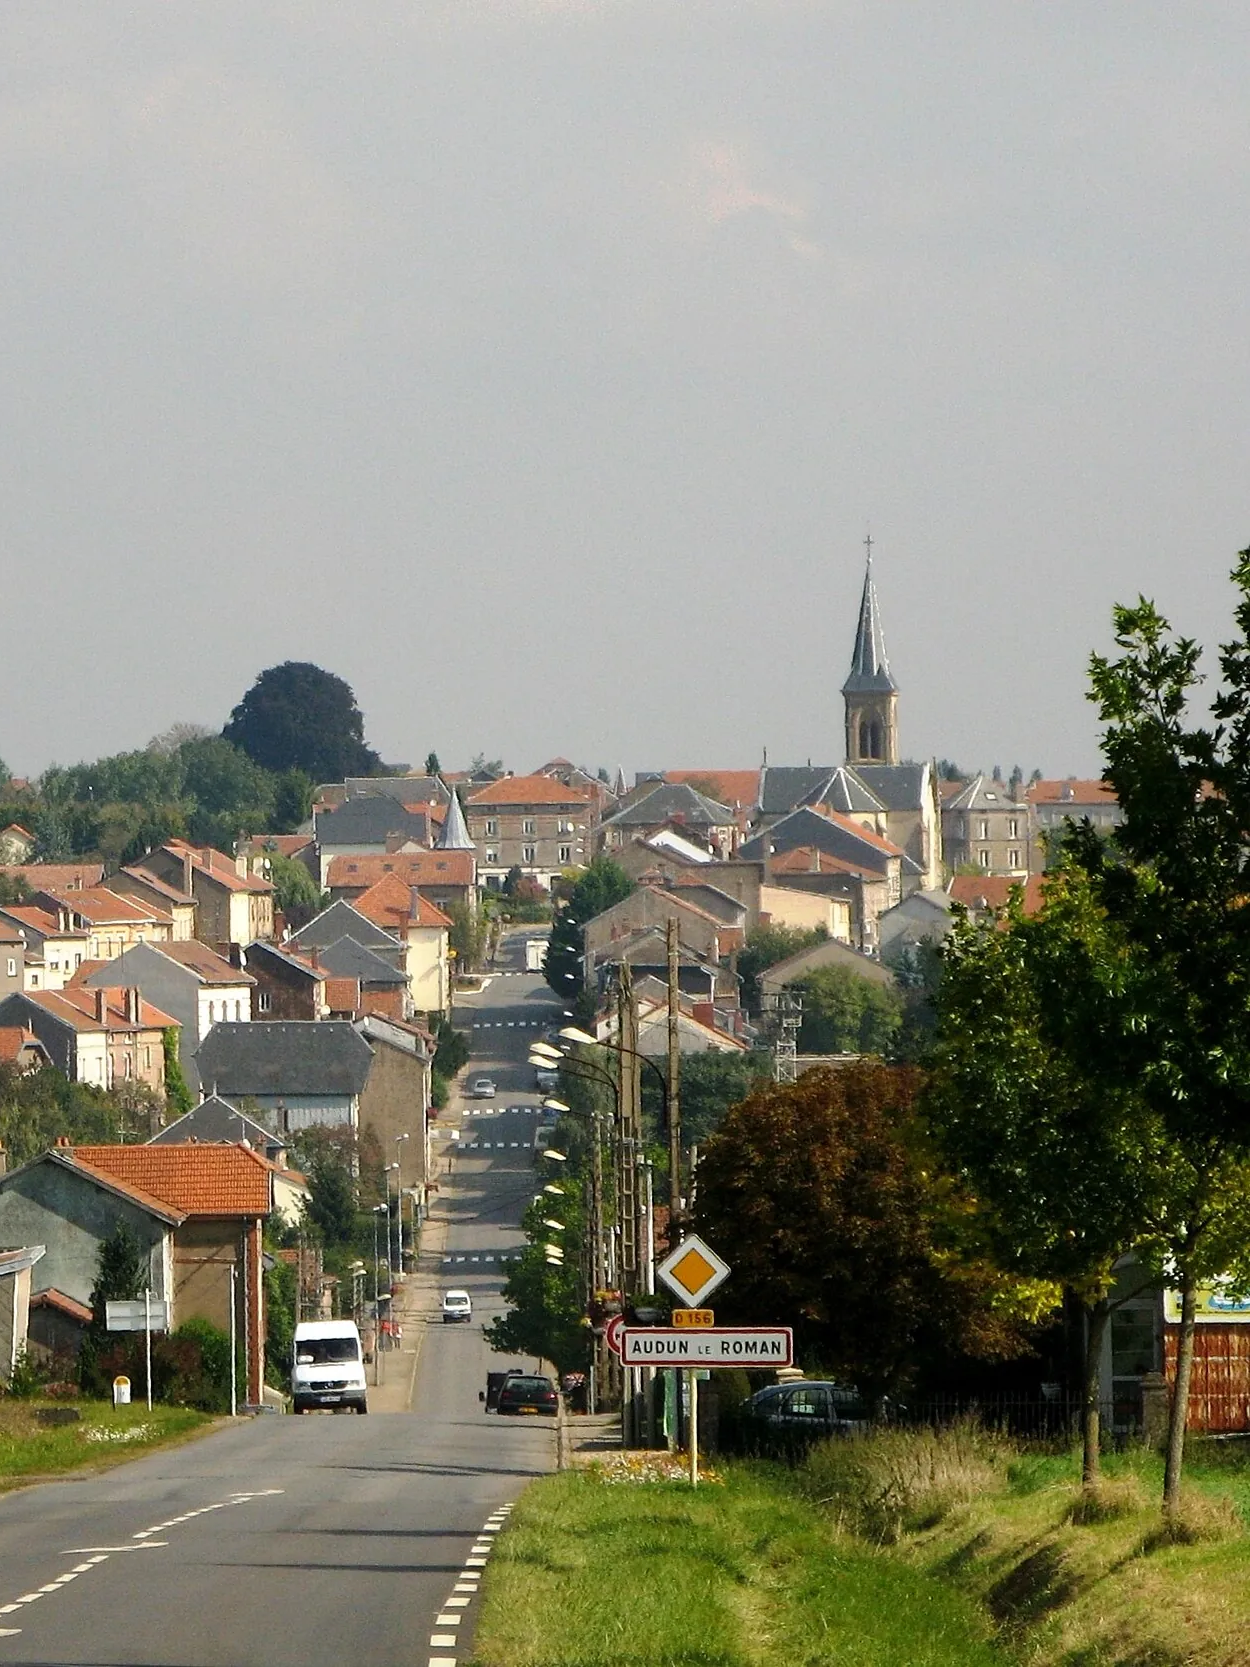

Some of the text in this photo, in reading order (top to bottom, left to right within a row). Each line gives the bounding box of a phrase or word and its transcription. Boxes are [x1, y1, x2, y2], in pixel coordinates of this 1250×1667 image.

[675, 1313, 711, 1323] D 156
[632, 1340, 781, 1355] AUDUN LE ROMAN
